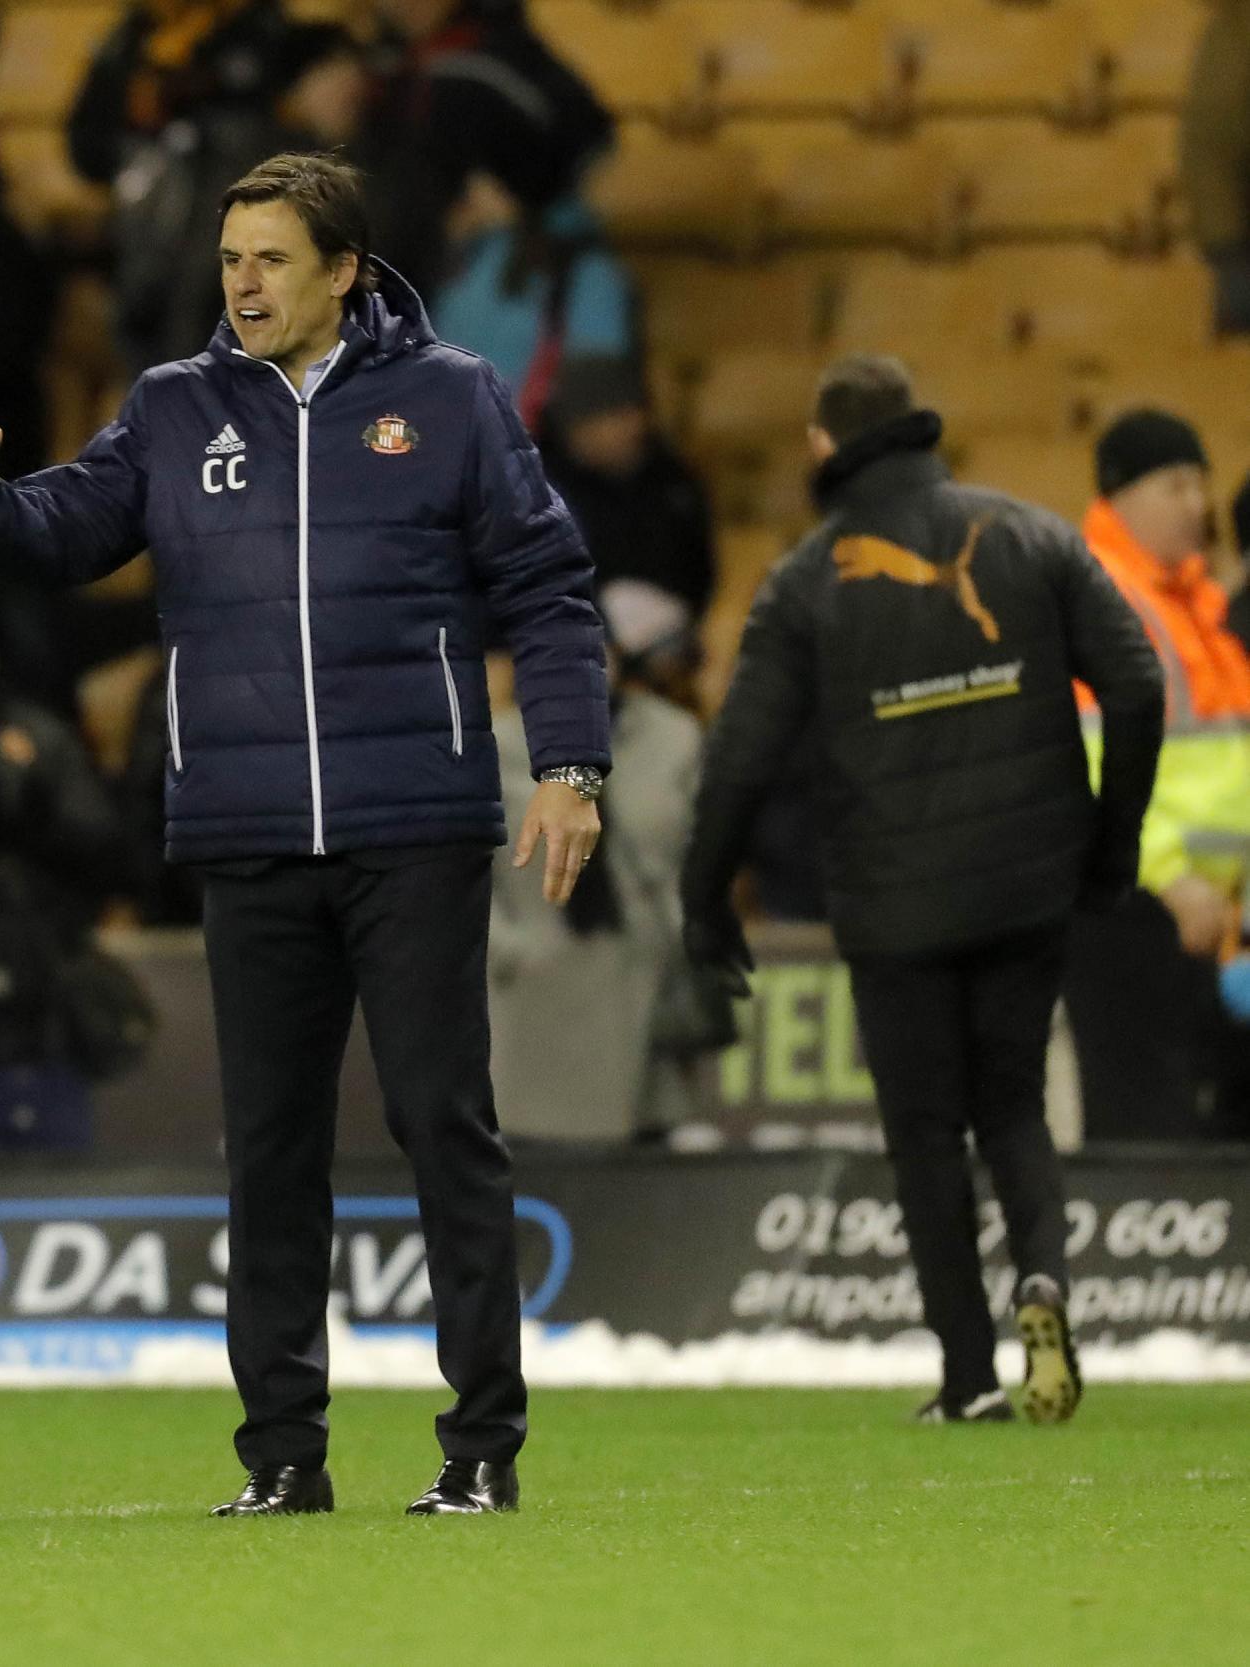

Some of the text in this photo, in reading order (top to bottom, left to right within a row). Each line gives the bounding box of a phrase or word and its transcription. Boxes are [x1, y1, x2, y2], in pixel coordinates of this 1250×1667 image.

[205, 441, 246, 454] adidas
[202, 455, 246, 493] CC
[1105, 1199, 1232, 1258] 606
[12, 1222, 168, 1314] DA
